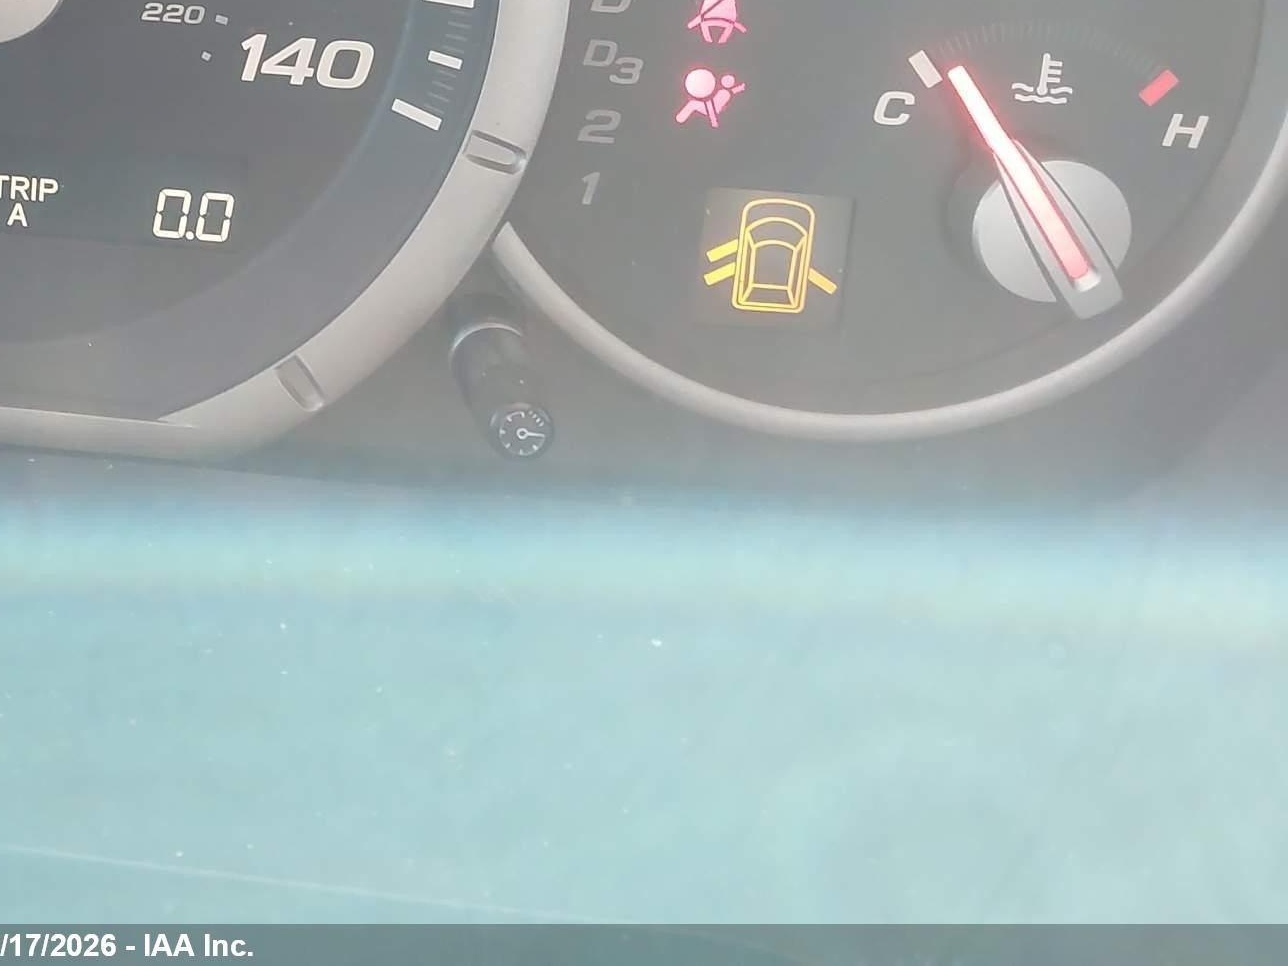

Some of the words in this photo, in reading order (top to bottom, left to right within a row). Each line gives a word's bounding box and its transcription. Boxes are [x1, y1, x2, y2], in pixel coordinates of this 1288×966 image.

[142, 3, 205, 23] 220
[242, 34, 374, 88] 140
[874, 91, 915, 125] C
[578, 110, 621, 143] 2
[1163, 114, 1209, 148] H
[582, 172, 600, 205] 1
[8, 203, 28, 226] A
[153, 189, 234, 242] 0.0
